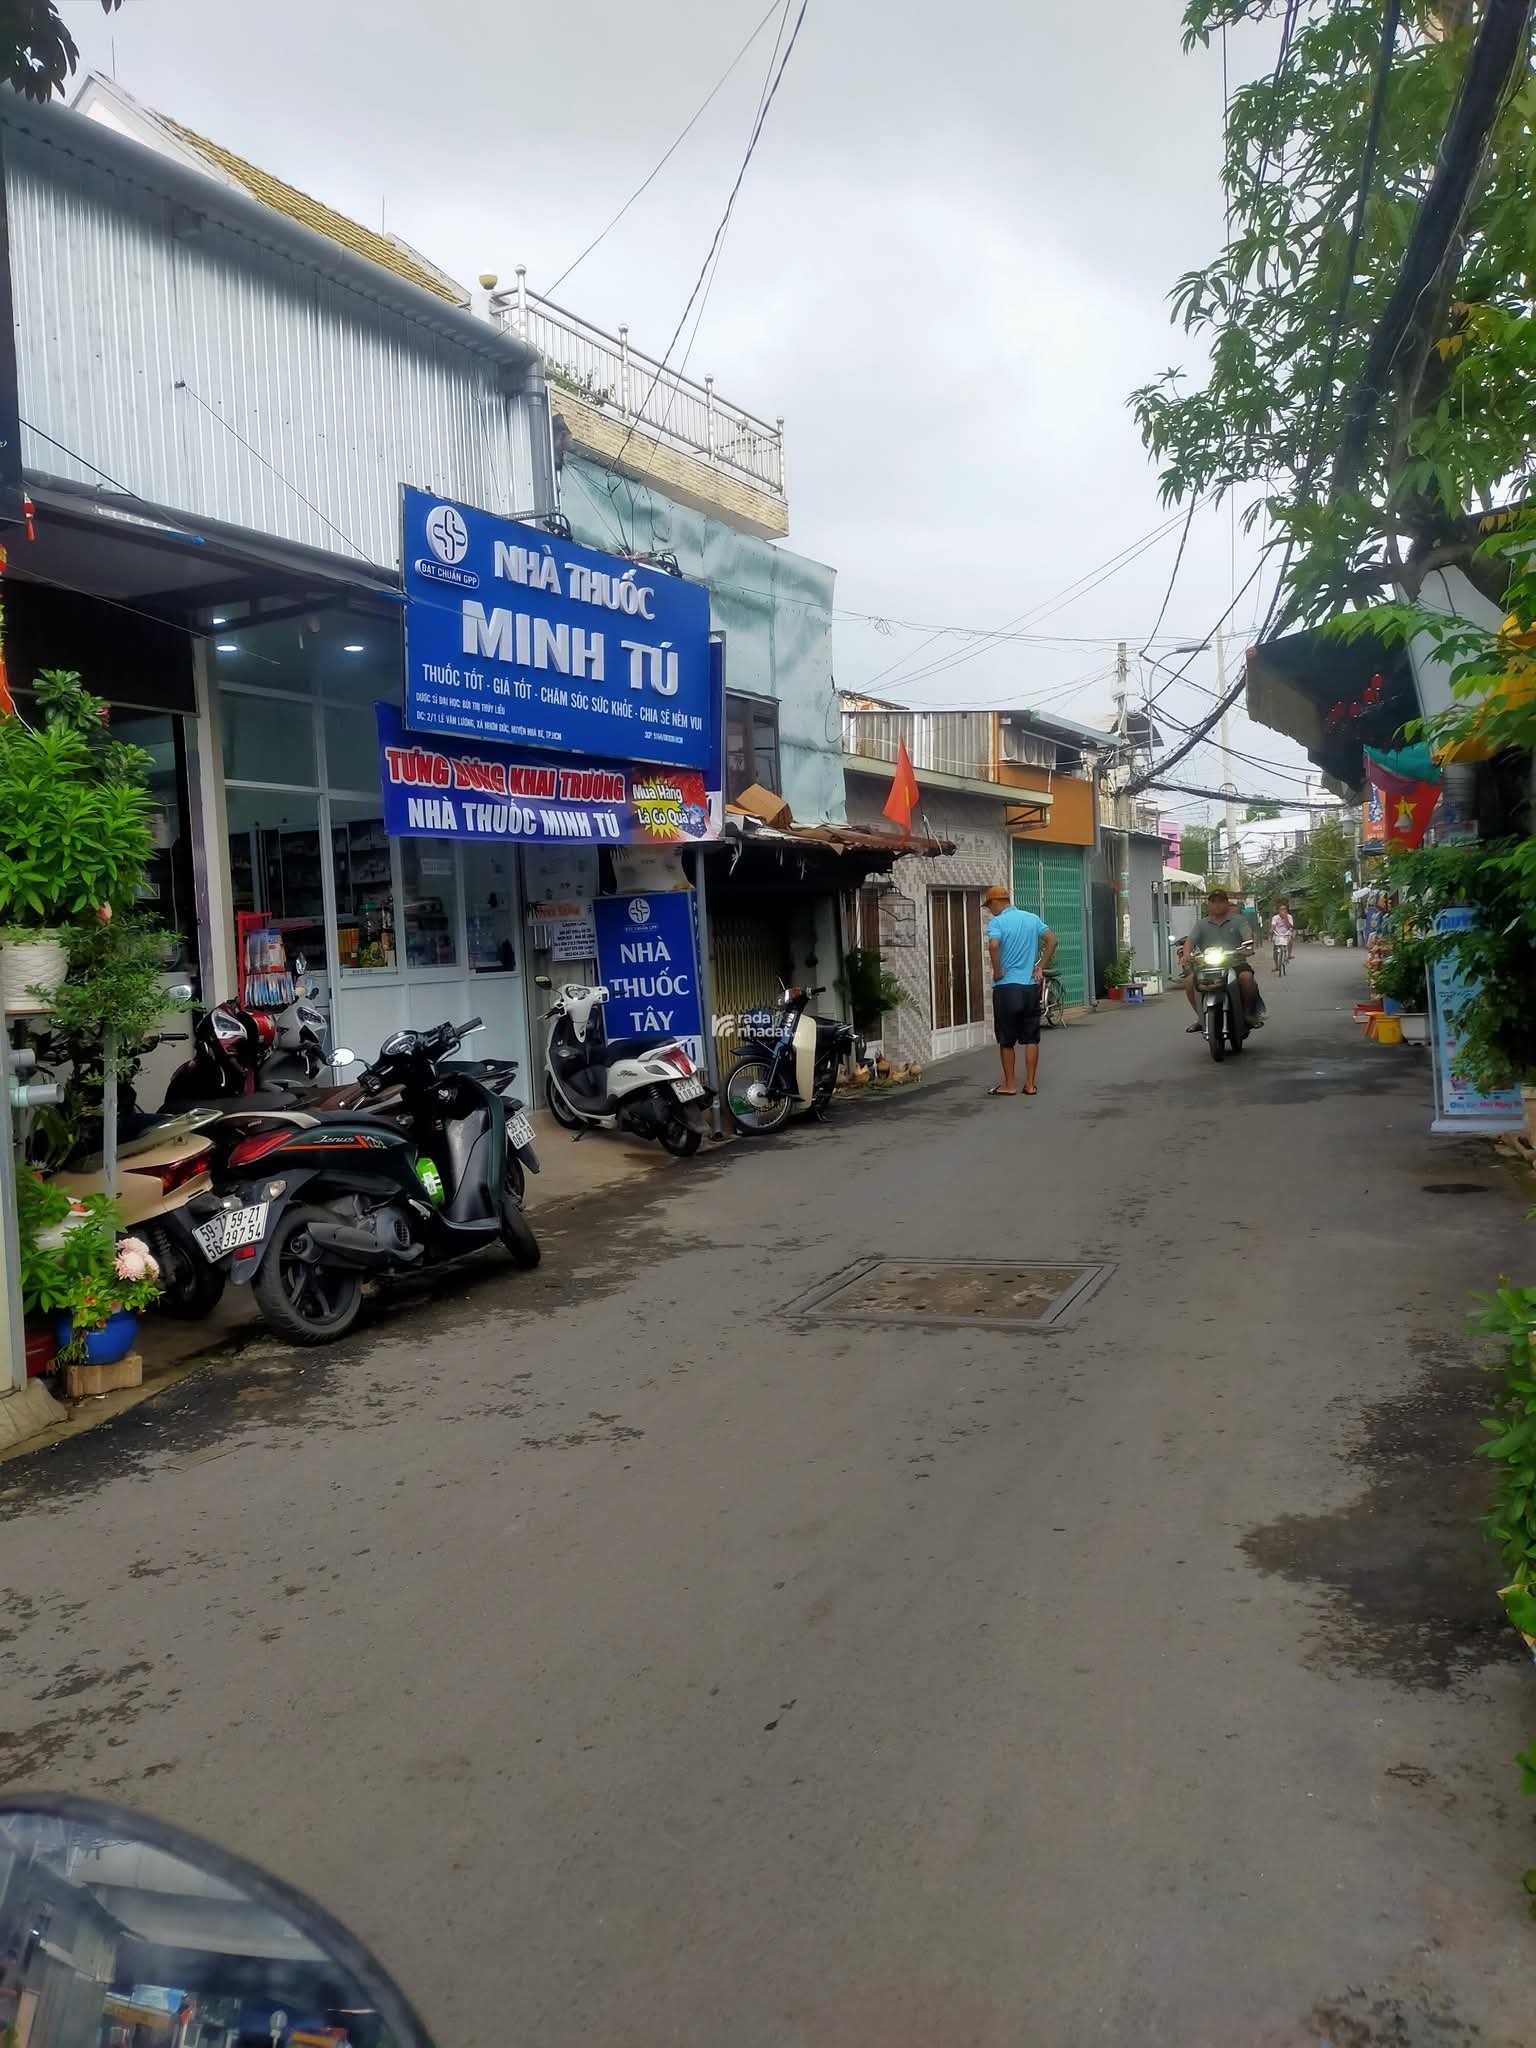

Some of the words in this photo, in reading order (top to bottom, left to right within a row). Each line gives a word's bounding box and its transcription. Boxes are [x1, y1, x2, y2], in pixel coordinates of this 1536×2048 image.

[463, 574, 477, 586] GPP
[494, 541, 562, 594] NHÀ
[565, 567, 655, 620] THUỐC
[462, 600, 605, 681] MINH
[621, 640, 679, 696] TÚ
[422, 662, 460, 687] THUỐC
[463, 667, 484, 691] TỐT
[493, 677, 510, 696] GIÁ
[513, 677, 532, 700] TỐT
[570, 691, 589, 710] SÓC
[591, 695, 609, 714] SỨC
[611, 698, 633, 719] KHỎE
[639, 706, 658, 723] CHIA
[690, 715, 702, 731] VUI
[385, 746, 451, 788] TƯNG
[508, 764, 557, 800] KHAI
[558, 767, 626, 804] TRƯƠNG
[632, 783, 657, 800] Mua
[656, 784, 683, 803] Hàng
[407, 796, 457, 830] NHÀ
[462, 798, 537, 835] THUỐC
[539, 809, 592, 837] MINH
[593, 809, 620, 838] TÚ
[620, 935, 672, 964] NHÀ
[609, 966, 690, 999] THUỐC
[629, 1006, 675, 1033] TÂY
[230, 1206, 260, 1229] 59-Z1
[223, 1222, 261, 1248] 397.54
